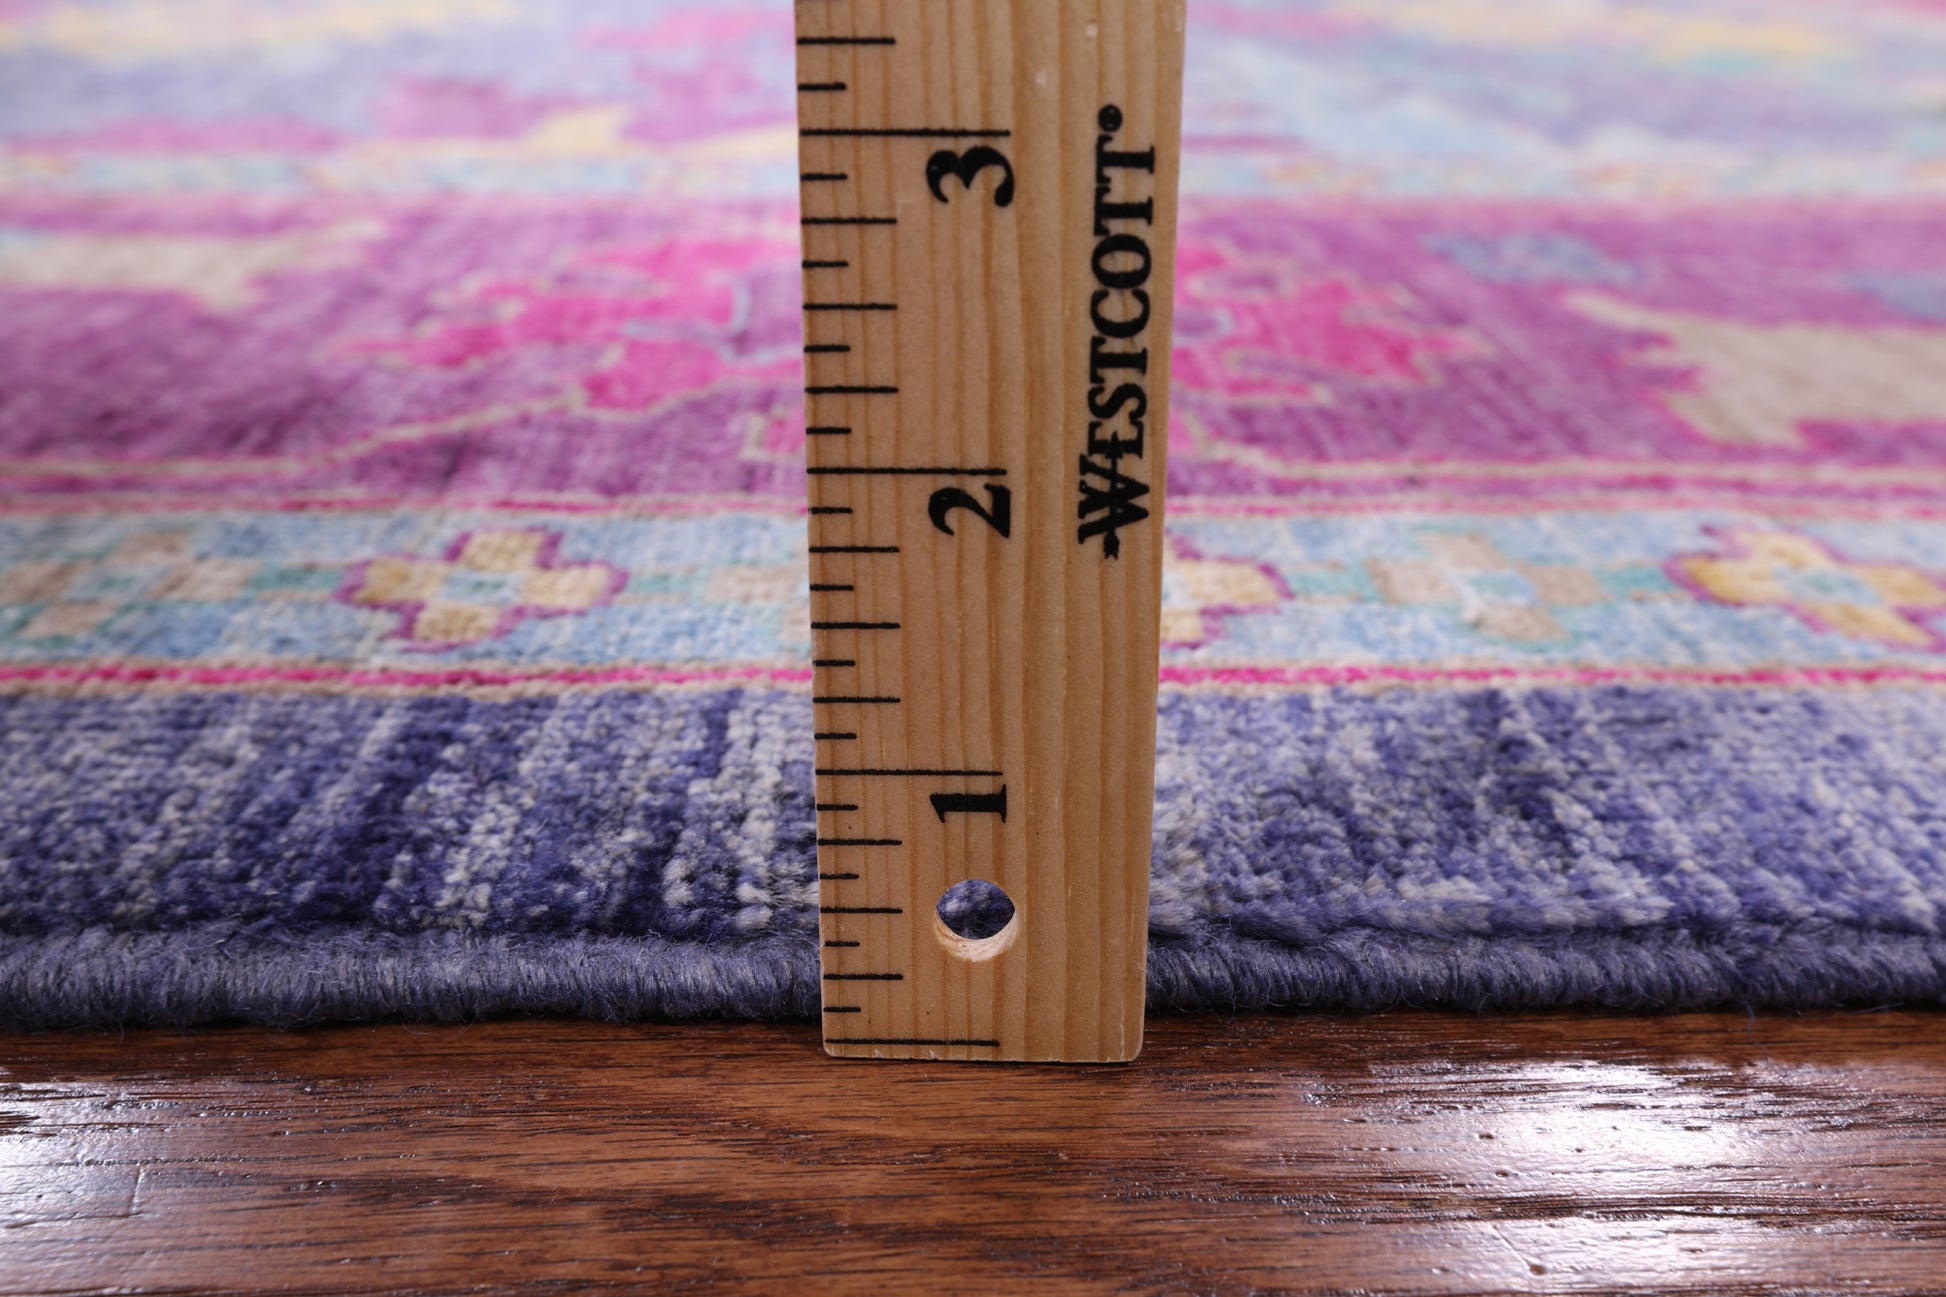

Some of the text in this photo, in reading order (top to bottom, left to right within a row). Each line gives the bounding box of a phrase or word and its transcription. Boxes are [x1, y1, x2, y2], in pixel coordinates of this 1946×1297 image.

[925, 145, 1015, 208] 3
[928, 482, 1012, 539] 2
[929, 784, 1007, 824] 1
